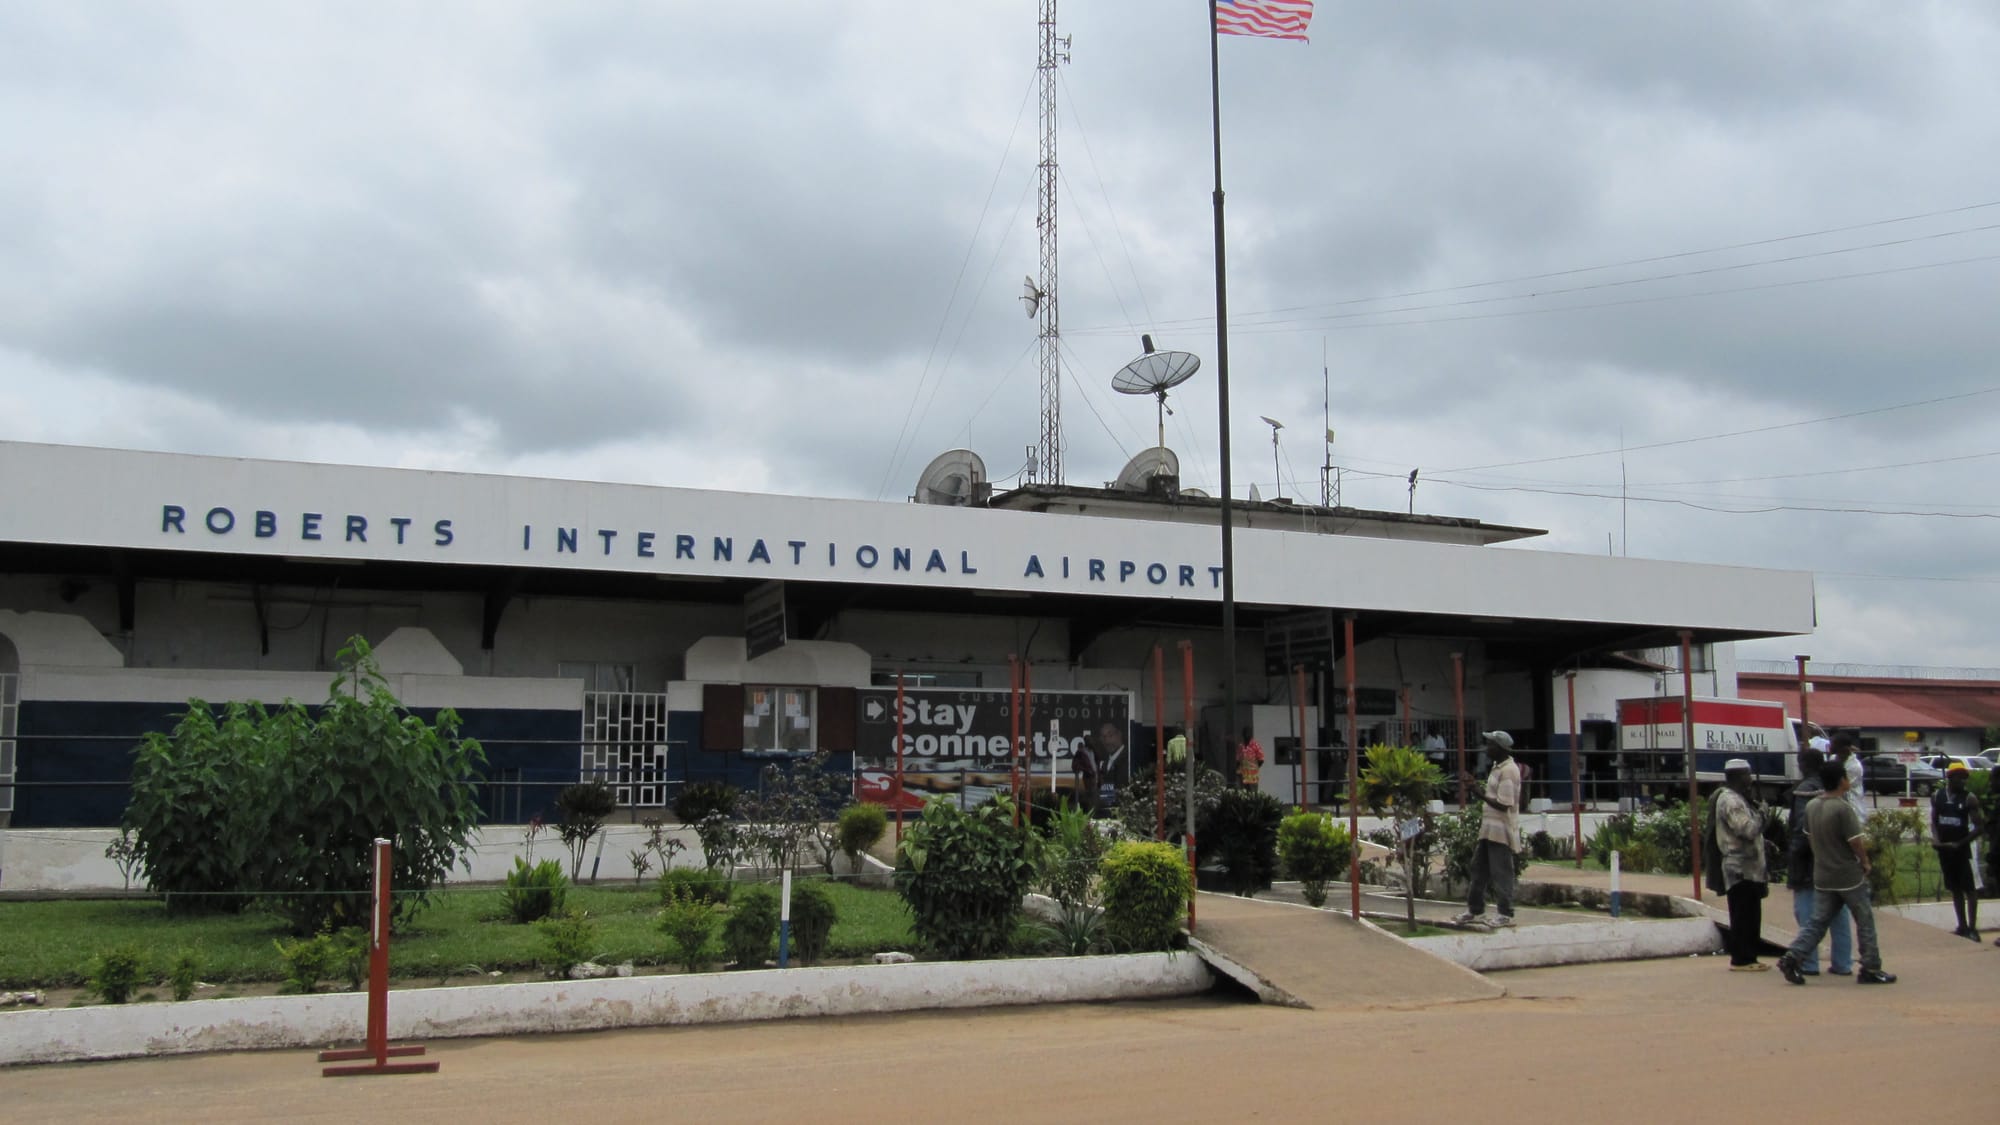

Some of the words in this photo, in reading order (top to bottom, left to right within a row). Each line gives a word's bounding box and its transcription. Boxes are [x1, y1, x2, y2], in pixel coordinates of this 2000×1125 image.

[163, 504, 454, 546] ROBERTS
[523, 526, 977, 574] INTERNATIONAL
[1024, 554, 1224, 588] AIRPORT
[892, 696, 977, 735] Stay
[1735, 731, 1768, 745] MAIL
